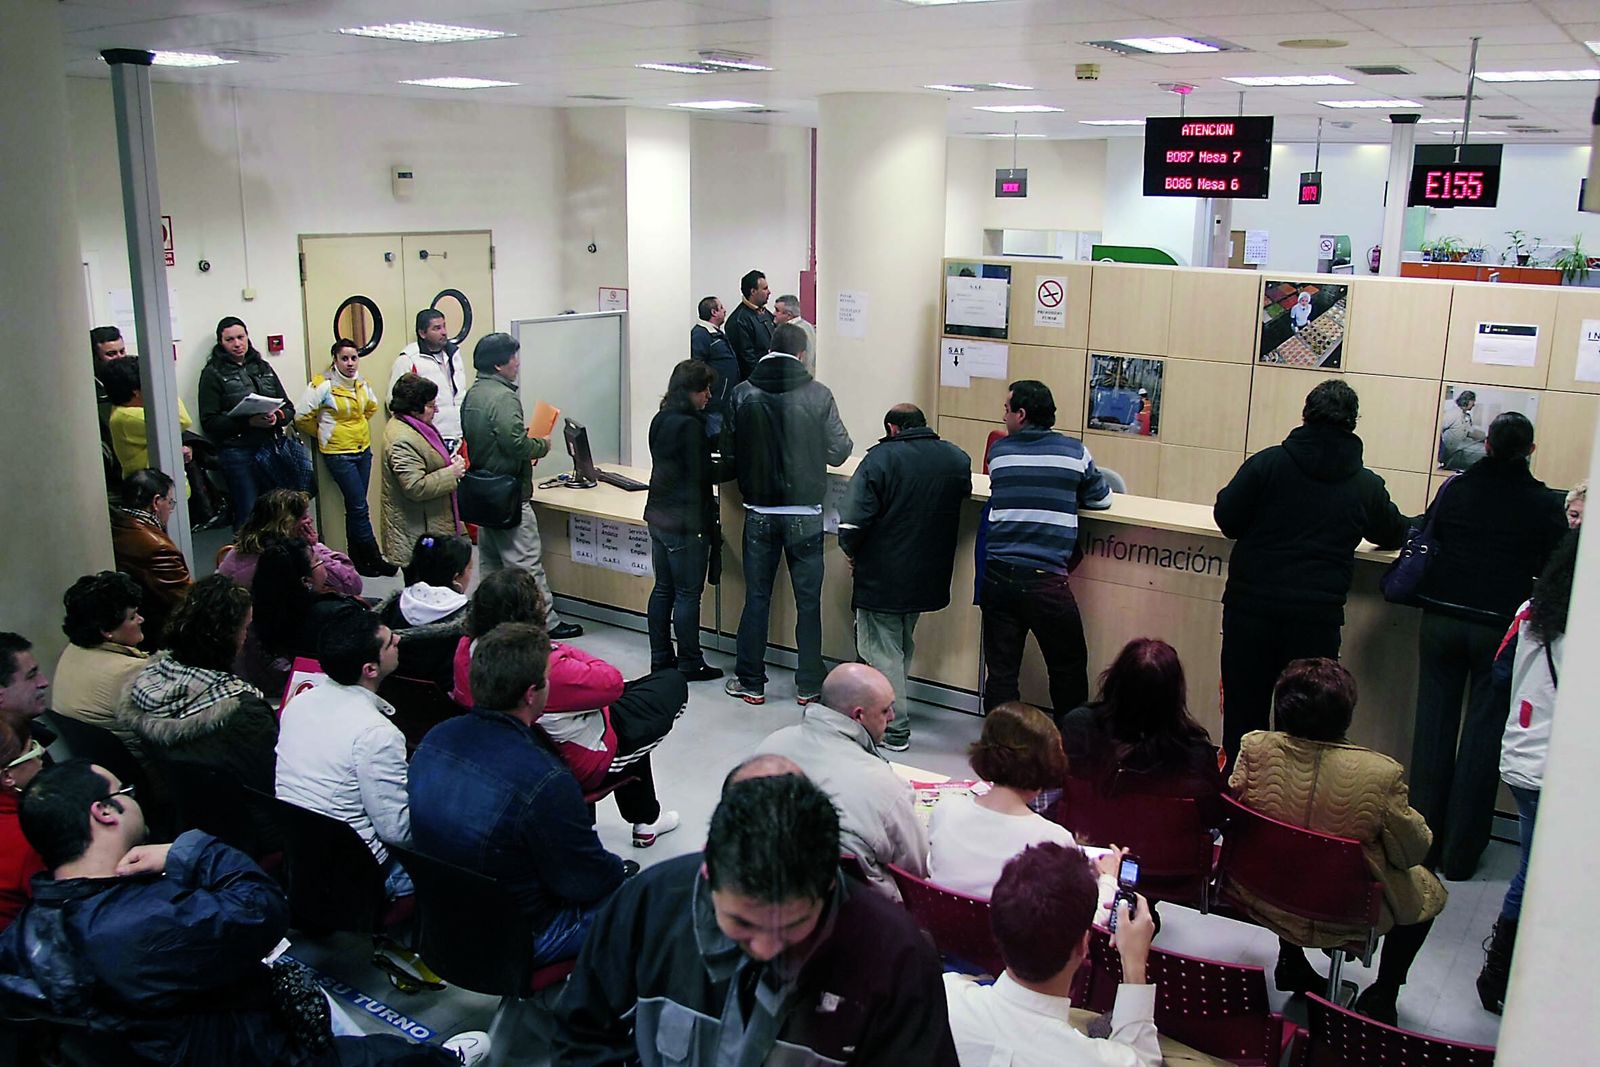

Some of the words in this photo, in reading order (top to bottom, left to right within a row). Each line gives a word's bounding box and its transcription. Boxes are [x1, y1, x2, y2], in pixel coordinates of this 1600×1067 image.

[1181, 123, 1234, 137] ATENCION
[1166, 150, 1194, 163] B087
[1198, 151, 1227, 163] Mesa
[1232, 151, 1241, 164] 7
[1453, 146, 1461, 164] 1
[1164, 177, 1192, 190] B086
[1197, 178, 1226, 191] Mesa
[1230, 178, 1239, 191] 6
[1425, 171, 1484, 199] E155
[1084, 531, 1223, 577] Información
[353, 992, 430, 1039] TURNO
